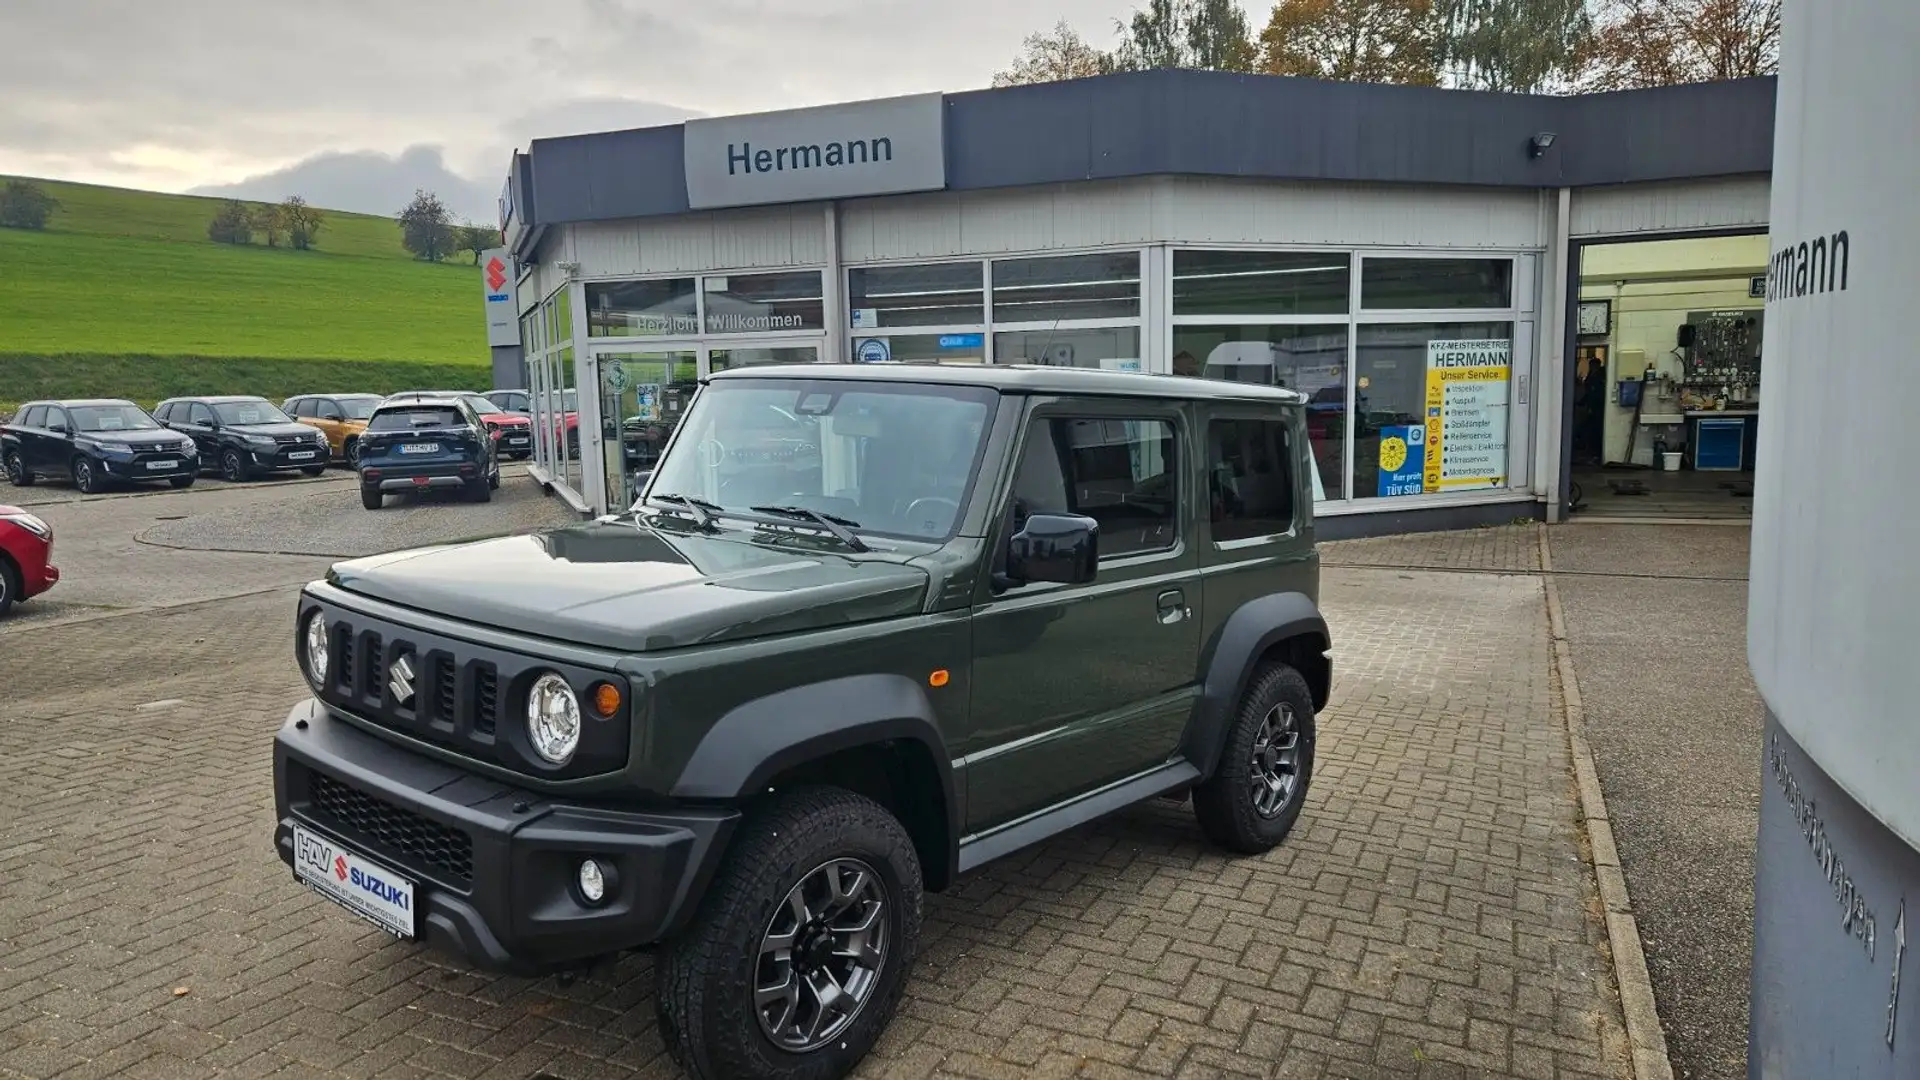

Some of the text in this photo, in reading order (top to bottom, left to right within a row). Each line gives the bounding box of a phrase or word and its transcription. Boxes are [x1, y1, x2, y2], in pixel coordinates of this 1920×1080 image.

[727, 136, 892, 176] Hermann
[1766, 230, 1849, 302] ermann
[637, 314, 803, 333] Herzlich Willkommen
[1435, 351, 1509, 368] HERMANN
[1440, 371, 1465, 381] Unser
[1386, 484, 1403, 496] TÜV
[1404, 483, 1422, 495] SÜD
[297, 832, 332, 873] HAV
[350, 866, 409, 911] SUZUKI
